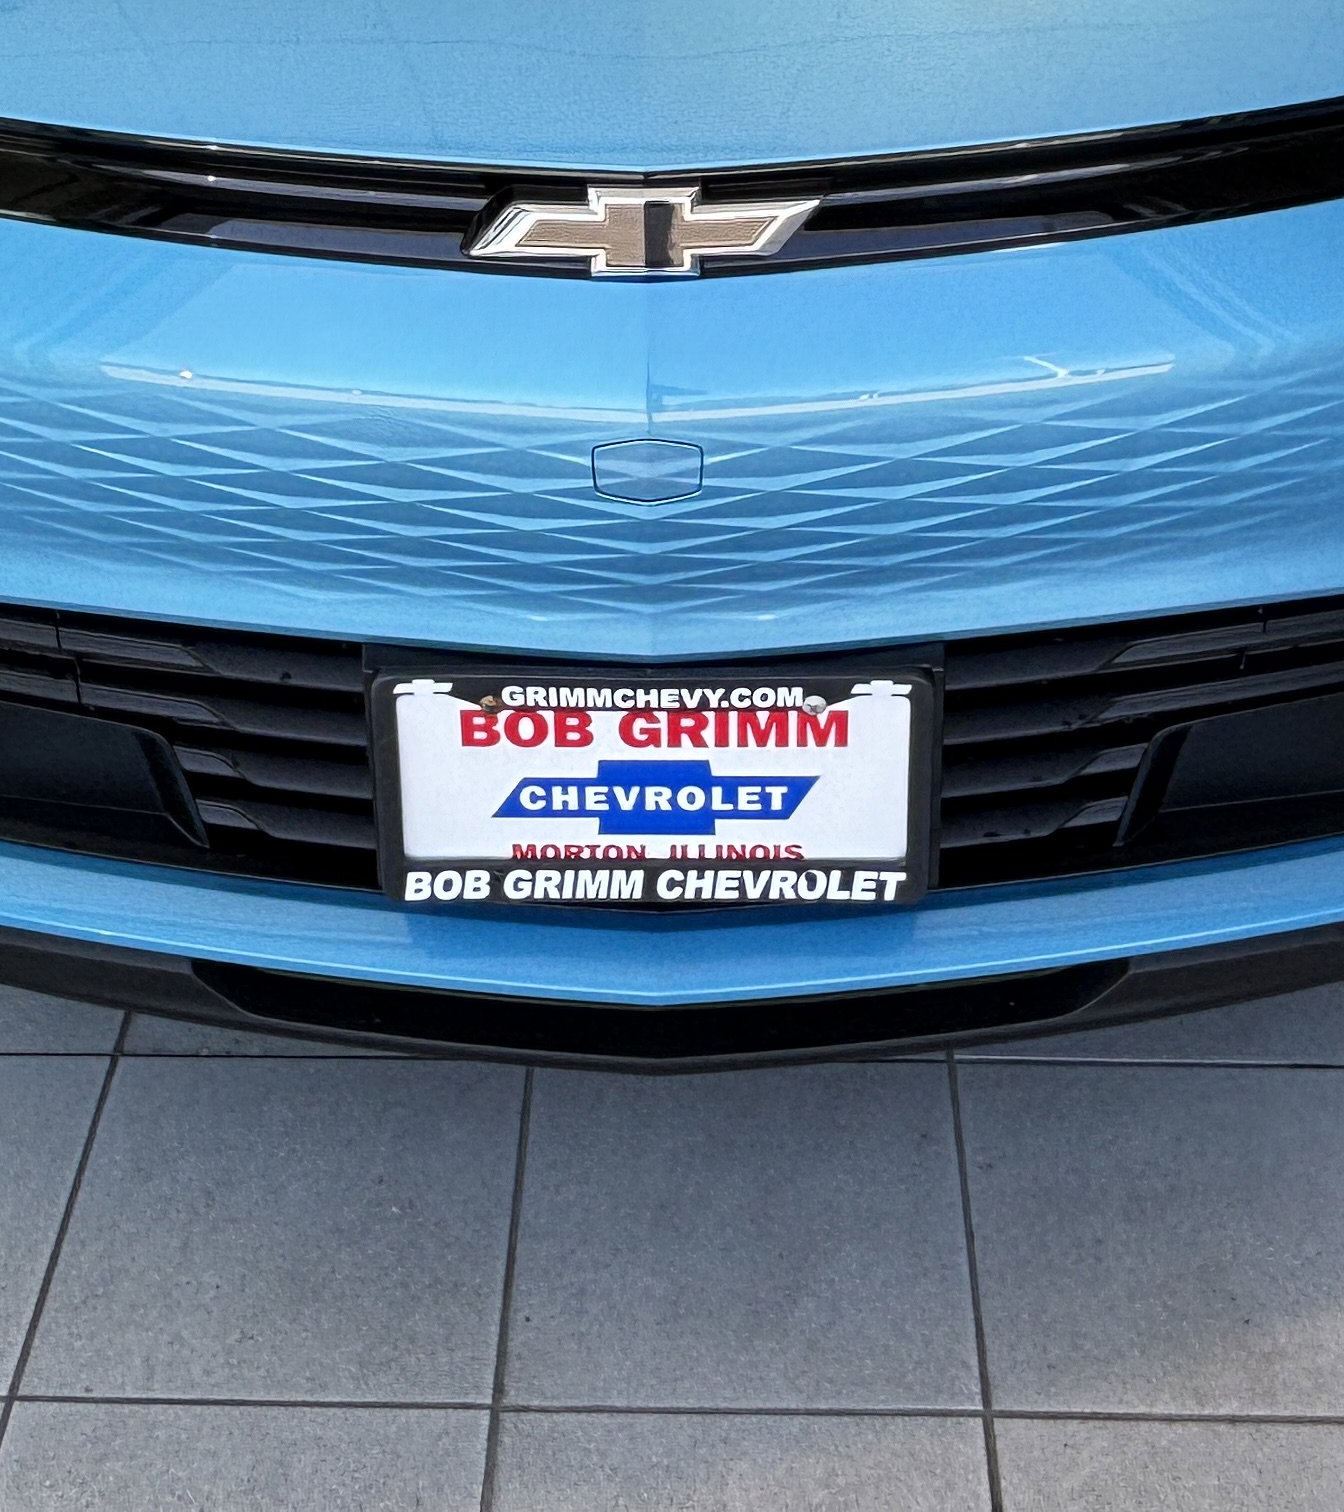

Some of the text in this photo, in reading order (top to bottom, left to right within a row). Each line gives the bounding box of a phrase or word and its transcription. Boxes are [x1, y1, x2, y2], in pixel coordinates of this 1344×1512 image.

[500, 685, 804, 710] GRIMMCHEVY.COM
[460, 709, 849, 749] BOB GRIMM
[518, 784, 789, 812] CHEVROLET
[669, 843, 806, 861] ILLINOIS
[404, 869, 907, 902] BOB GRIMM CHEVROLET
